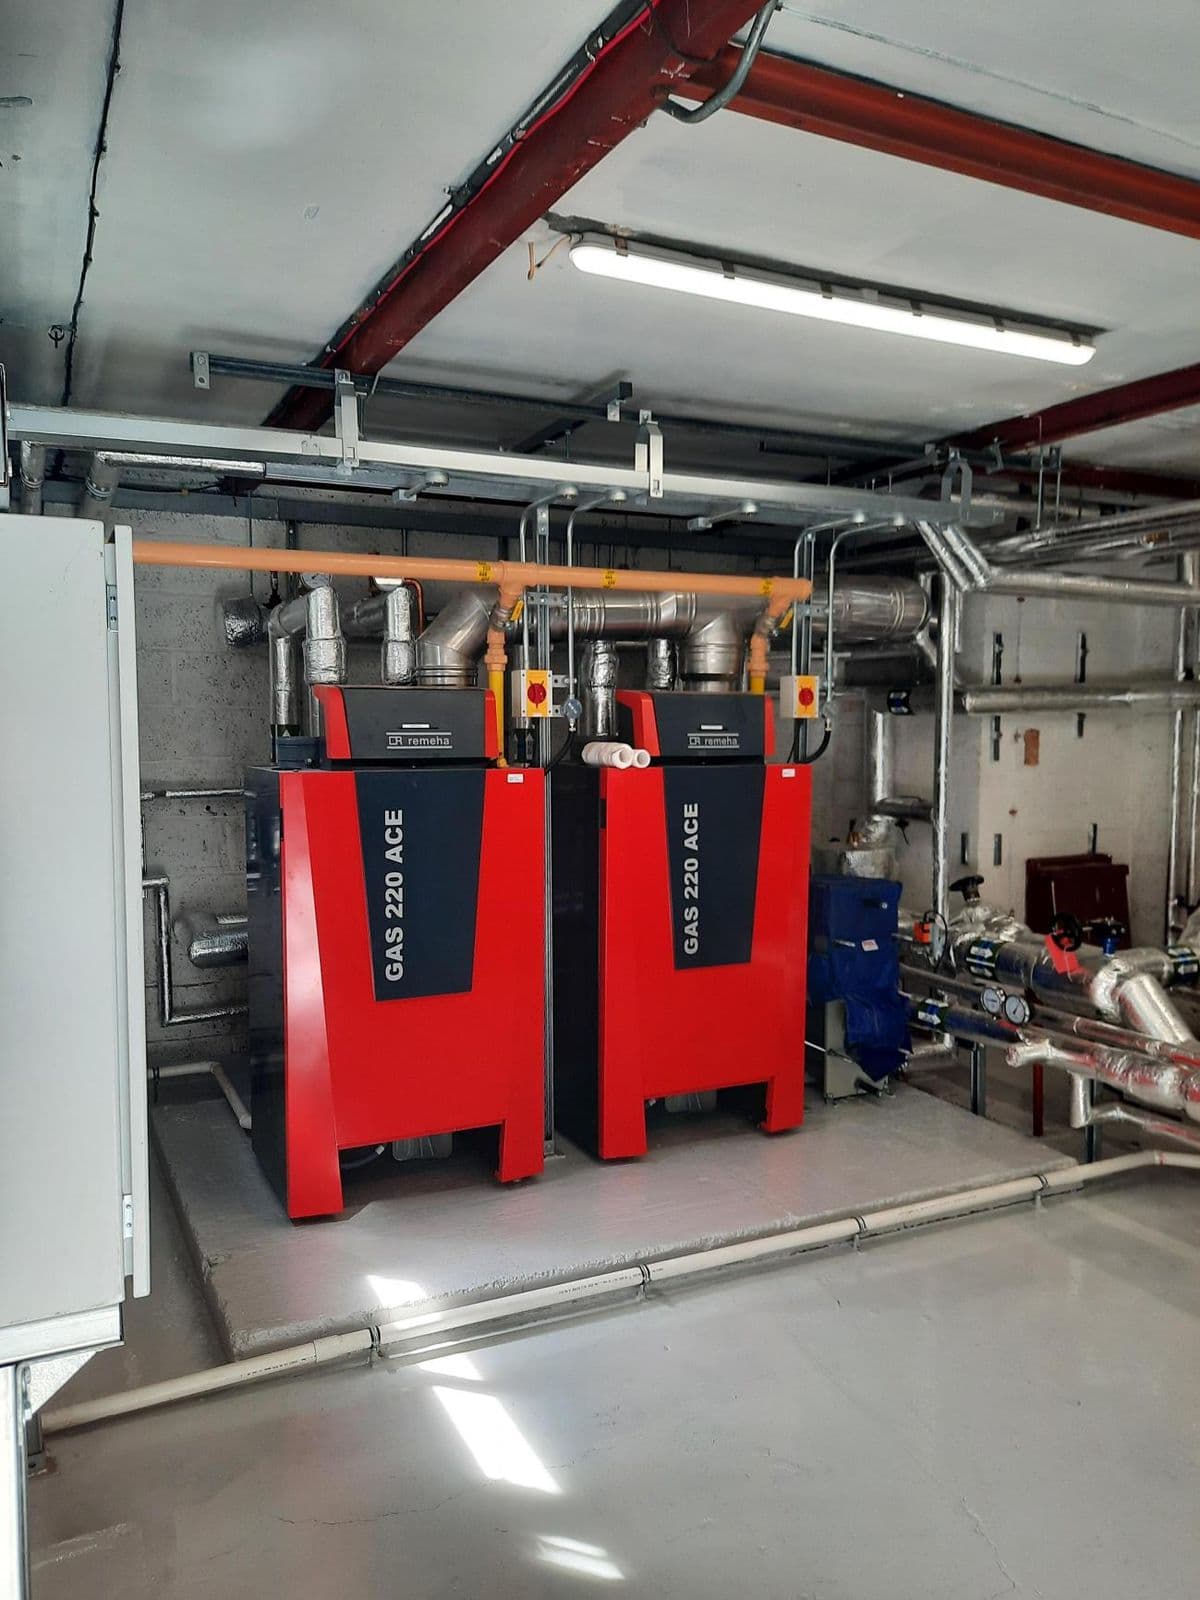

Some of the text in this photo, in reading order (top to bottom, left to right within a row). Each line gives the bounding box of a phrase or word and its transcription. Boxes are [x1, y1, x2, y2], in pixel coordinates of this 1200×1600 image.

[408, 736, 450, 745] remeha
[704, 736, 738, 745] remeha
[384, 809, 404, 982] GAS 220 ACE
[684, 803, 699, 955] GAS 220 ACE
